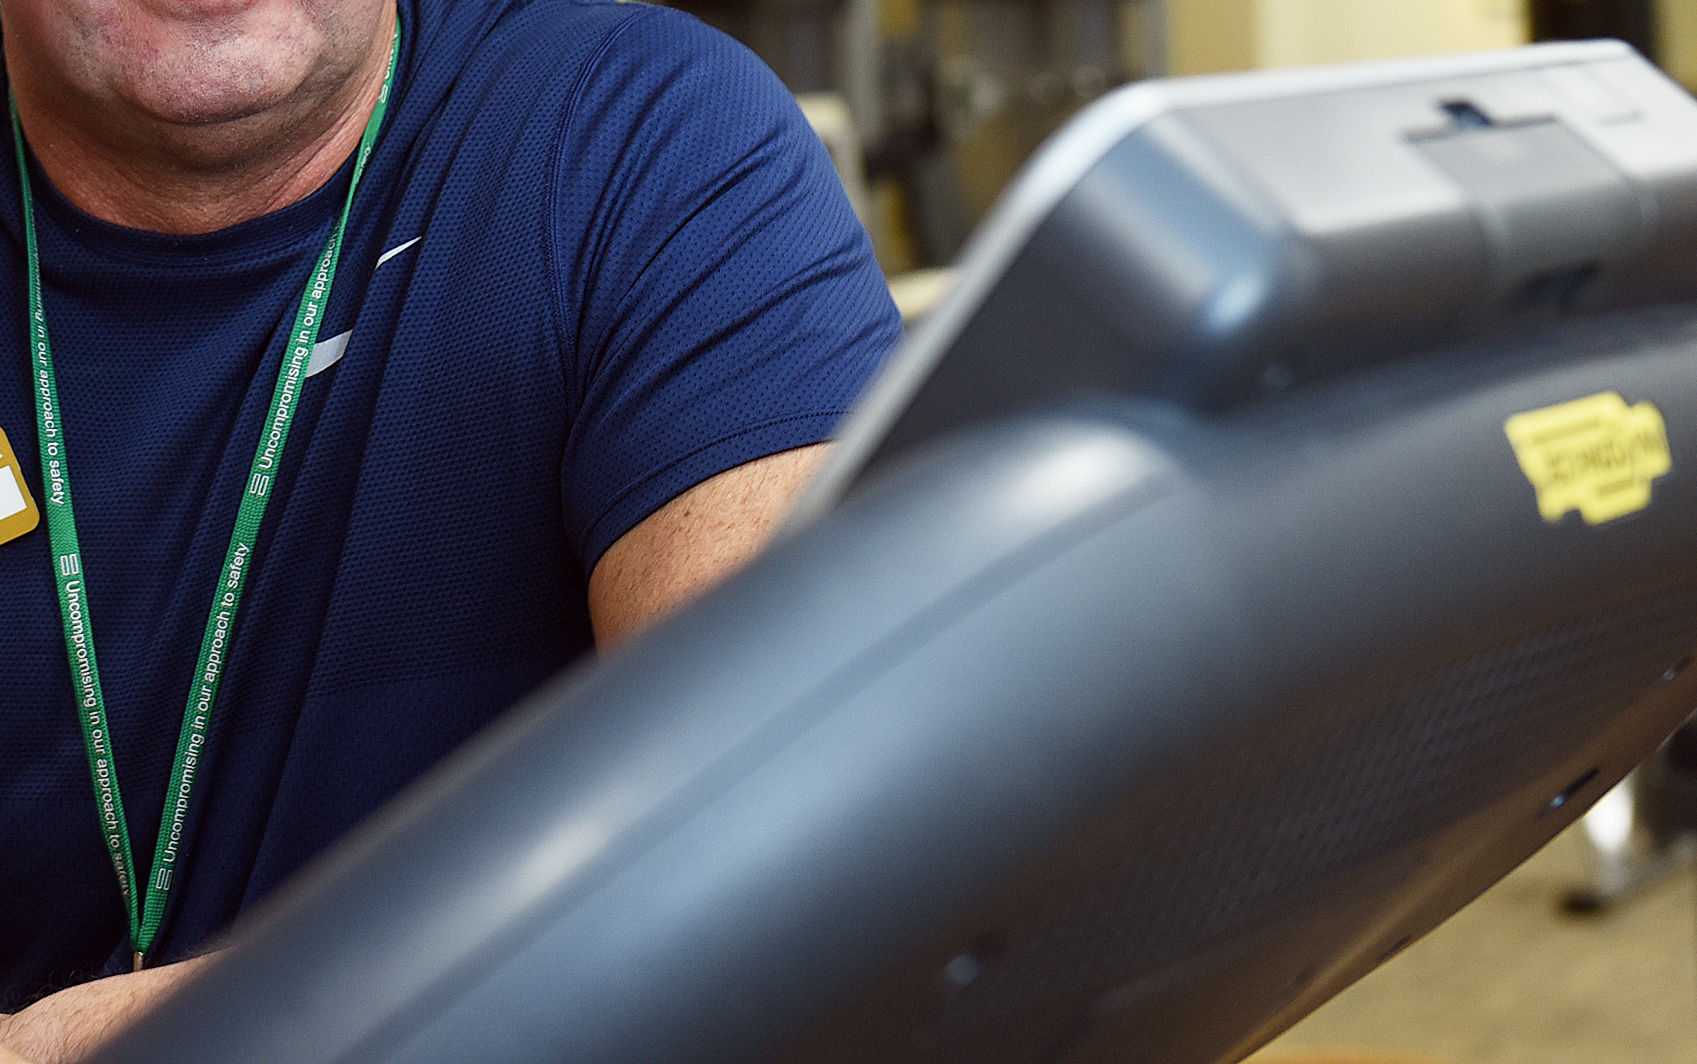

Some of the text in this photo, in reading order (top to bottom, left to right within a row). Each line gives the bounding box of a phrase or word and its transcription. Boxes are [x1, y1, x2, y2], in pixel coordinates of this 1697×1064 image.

[37, 325, 45, 338] in
[37, 342, 48, 367] our
[258, 346, 309, 469] Uncompromising
[296, 328, 310, 344] in
[303, 301, 319, 327] our
[39, 369, 58, 438] approach
[47, 442, 59, 456] to
[49, 460, 64, 505] safety
[65, 580, 97, 708] Uncompromising
[89, 710, 101, 725] in
[162, 542, 250, 863] Uncompromising in our approach to safety
[92, 729, 106, 754] our
[96, 758, 119, 830] approach
[110, 834, 121, 849] to
